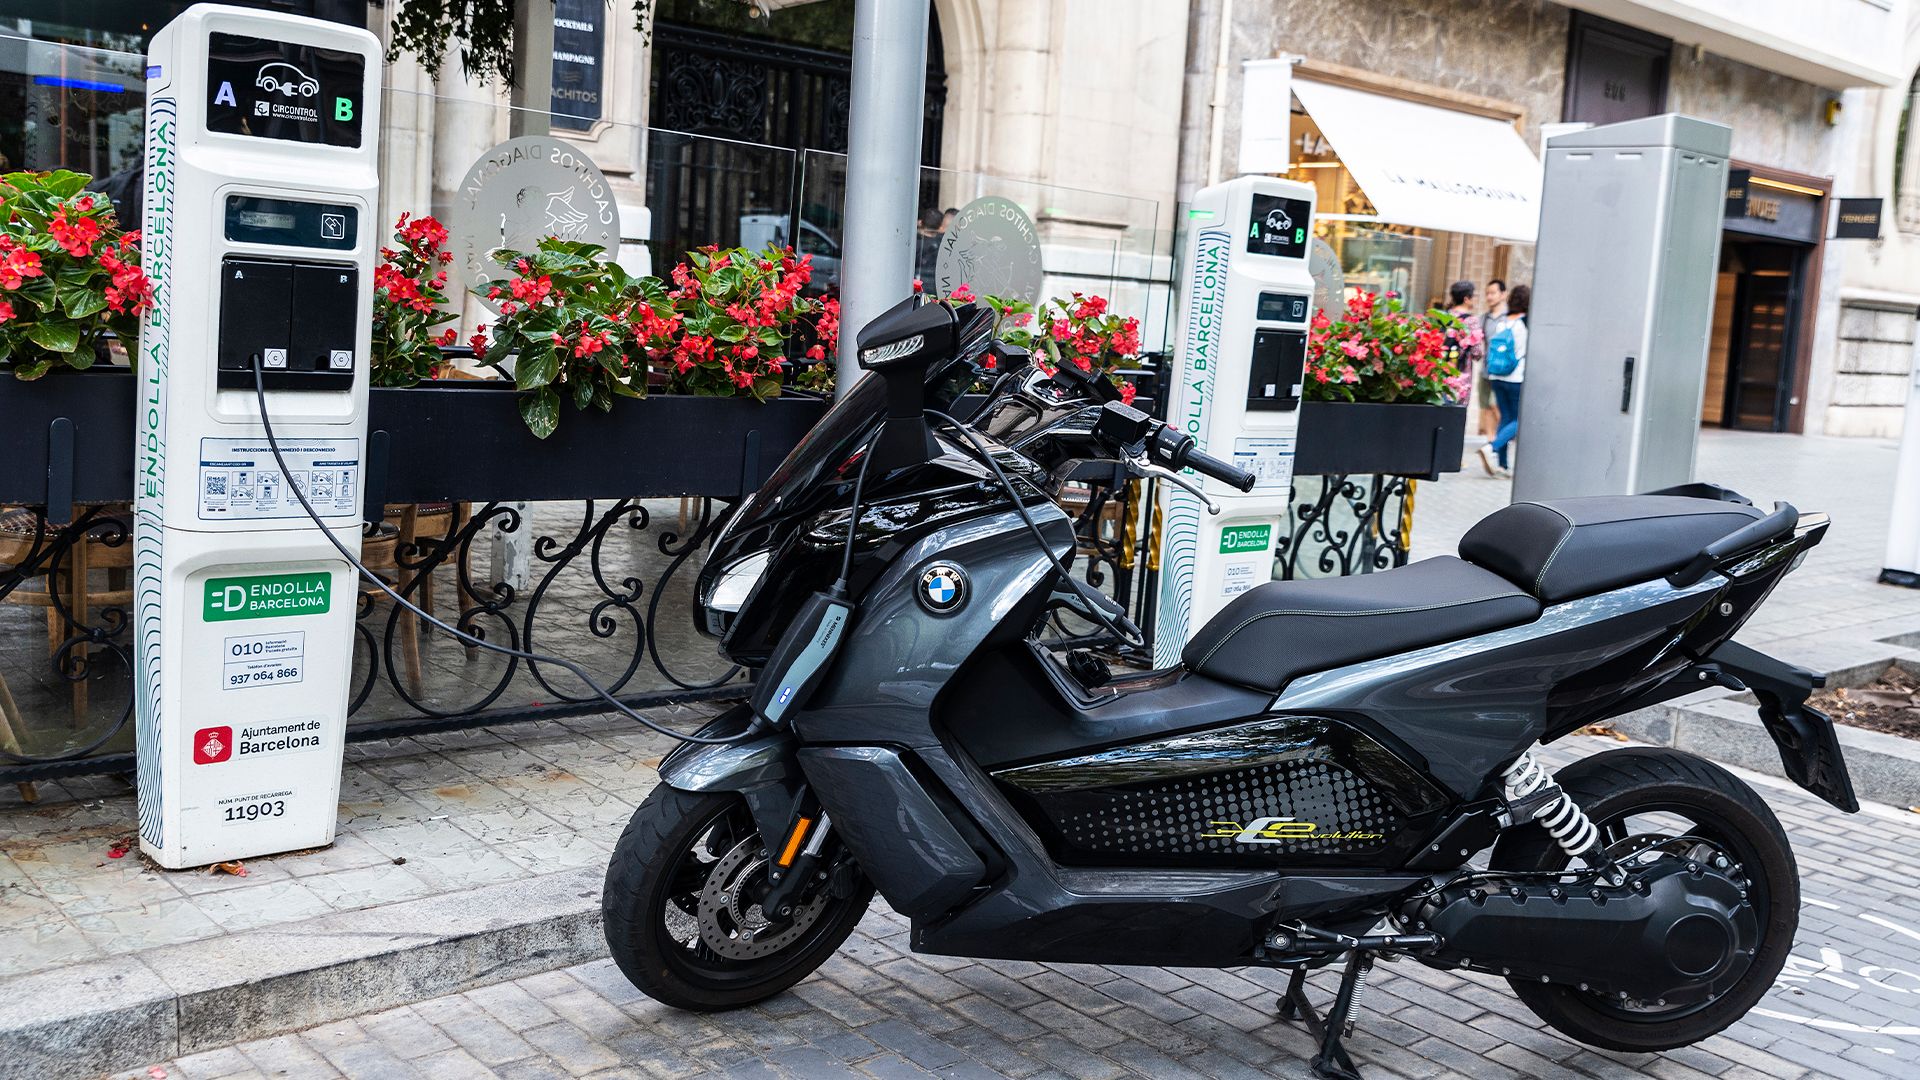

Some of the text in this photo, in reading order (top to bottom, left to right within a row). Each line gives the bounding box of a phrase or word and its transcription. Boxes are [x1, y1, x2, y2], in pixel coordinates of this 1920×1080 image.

[554, 18, 594, 32] OCKTAILS
[553, 51, 595, 66] AMPAGNE
[214, 81, 237, 107] A
[551, 87, 598, 103] ACHITOS
[272, 103, 318, 118] CIRCONTROL
[335, 97, 354, 122] B
[1250, 222, 1259, 239] A
[1295, 228, 1304, 244] B
[146, 121, 168, 498] ENDOLLA BARCELONA
[1183, 245, 1221, 475] EOLLA BARCELONA
[923, 567, 961, 583] BMW
[250, 580, 326, 597] ENDOLLA
[249, 596, 325, 611] BARCELONA
[232, 641, 264, 657] 010
[230, 667, 298, 685] 937 064 866
[241, 720, 321, 740] Ajuntament de
[240, 735, 320, 755] Barcelona
[234, 795, 251, 803] PUNT
[225, 800, 285, 822] 11903
